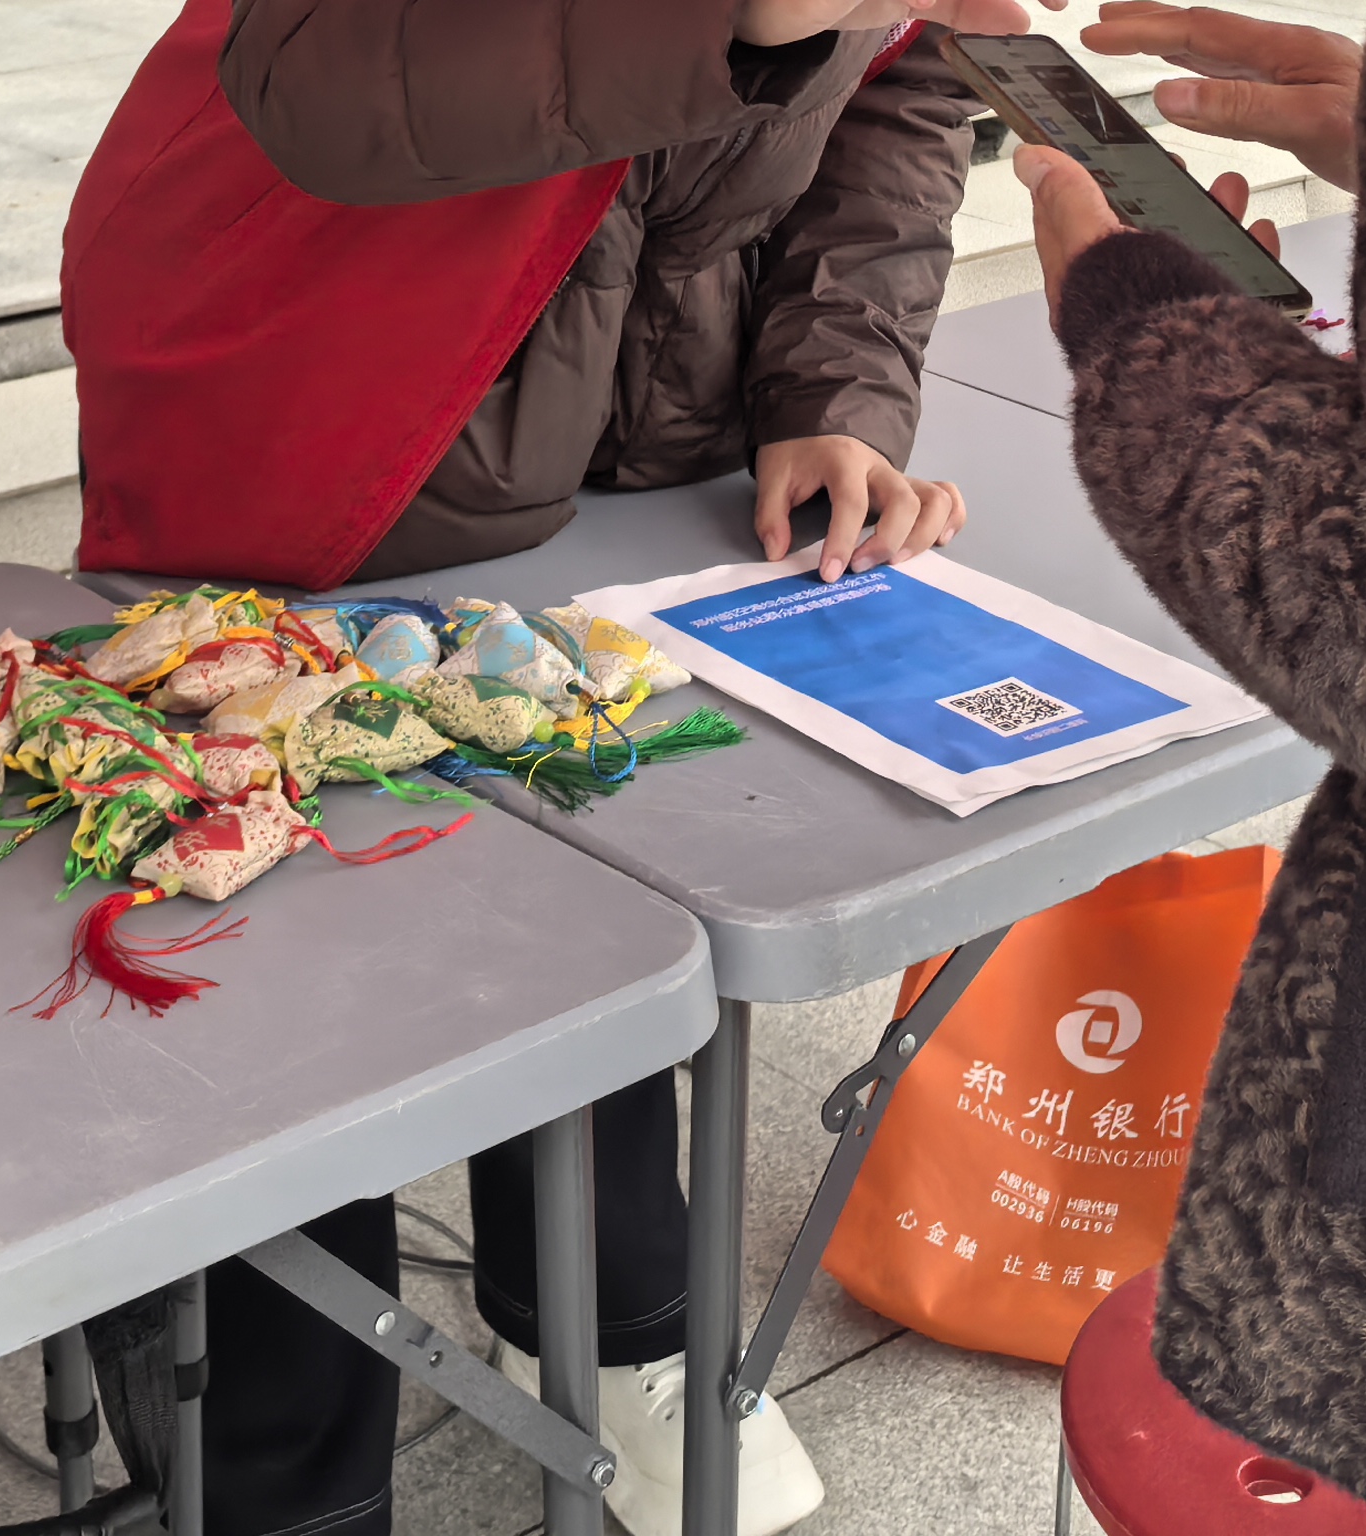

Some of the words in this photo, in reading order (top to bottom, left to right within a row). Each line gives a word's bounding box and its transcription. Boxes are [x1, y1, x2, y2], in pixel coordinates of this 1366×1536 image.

[956, 1093, 1015, 1137] BANK
[1020, 1128, 1050, 1150] OF
[962, 1060, 1191, 1141] 郑州银行
[991, 1189, 1045, 1223] 002936
[1060, 1217, 1114, 1234] 06196
[997, 1170, 1051, 1205] A股代码
[896, 1208, 978, 1261] 心金融
